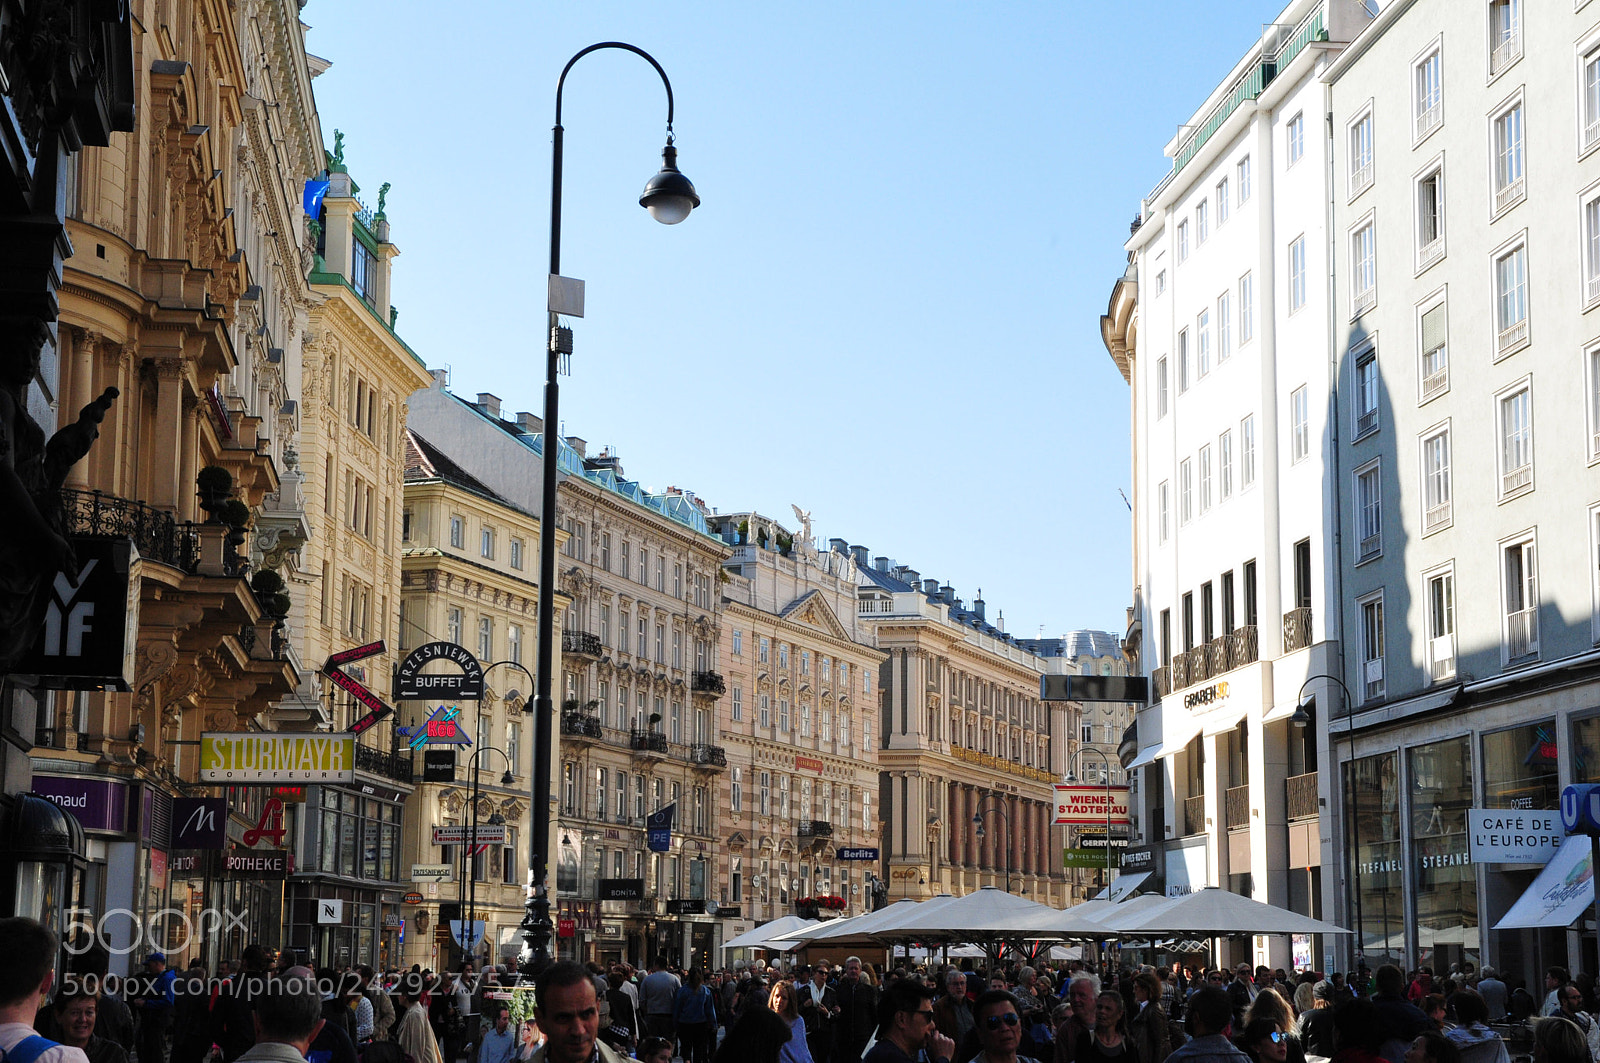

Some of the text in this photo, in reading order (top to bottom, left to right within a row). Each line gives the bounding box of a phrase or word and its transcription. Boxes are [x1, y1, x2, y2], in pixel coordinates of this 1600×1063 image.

[415, 677, 463, 687] BUFFET
[330, 671, 382, 712] FLEDERMAUS
[211, 737, 344, 770] STURMAYR
[1070, 795, 1115, 804] WIENER
[1058, 804, 1127, 814] STADTBRÄU
[1562, 793, 1577, 827] U
[1483, 817, 1552, 830] CAFÉ DE
[1082, 839, 1108, 847] GERRY
[1476, 834, 1561, 847] L'EUROPE
[843, 849, 874, 858] Berlitz
[227, 856, 283, 871] APOTHEKE
